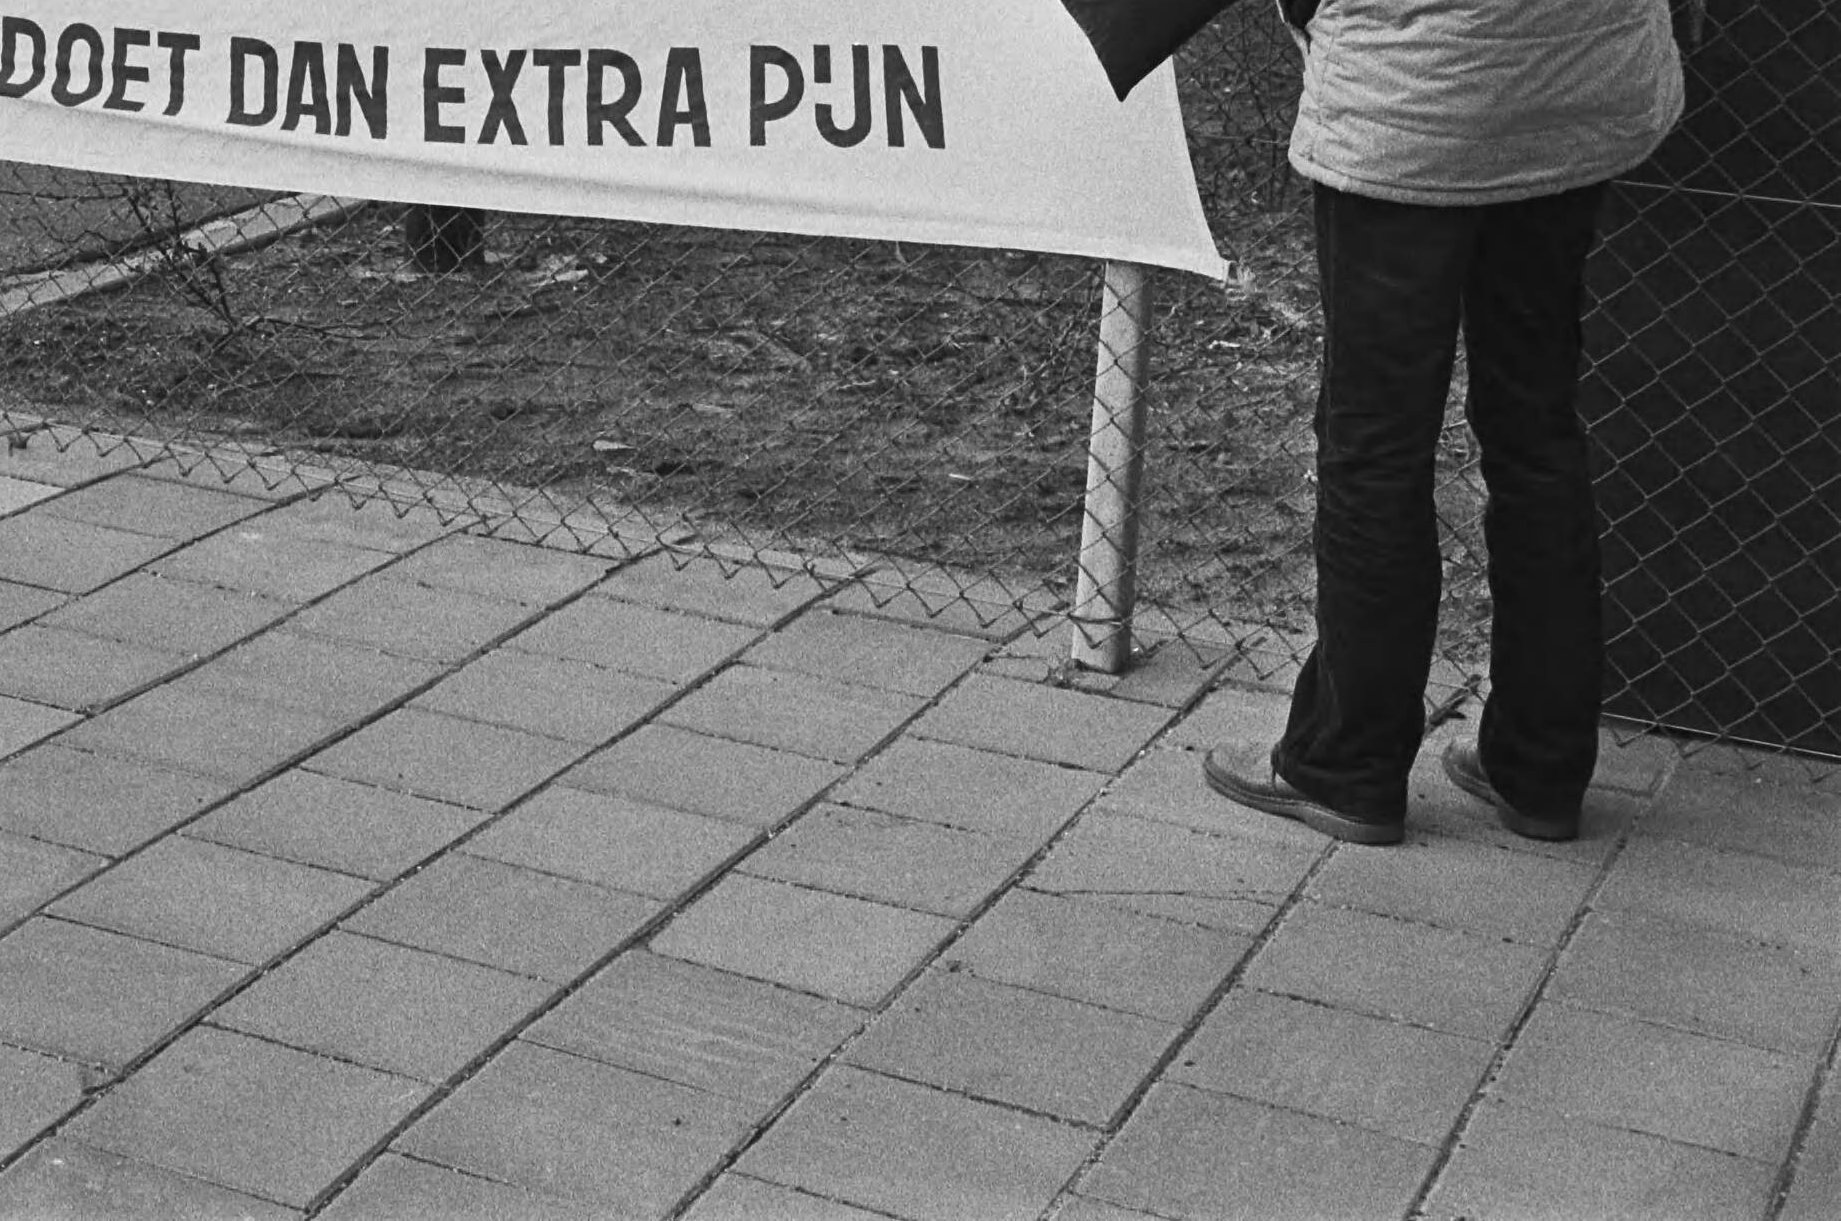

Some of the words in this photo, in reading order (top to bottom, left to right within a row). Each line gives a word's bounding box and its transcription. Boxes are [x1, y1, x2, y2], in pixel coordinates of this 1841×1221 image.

[226, 36, 389, 140] DAN
[424, 47, 712, 148] EXTRA
[749, 44, 947, 150] PIJN
